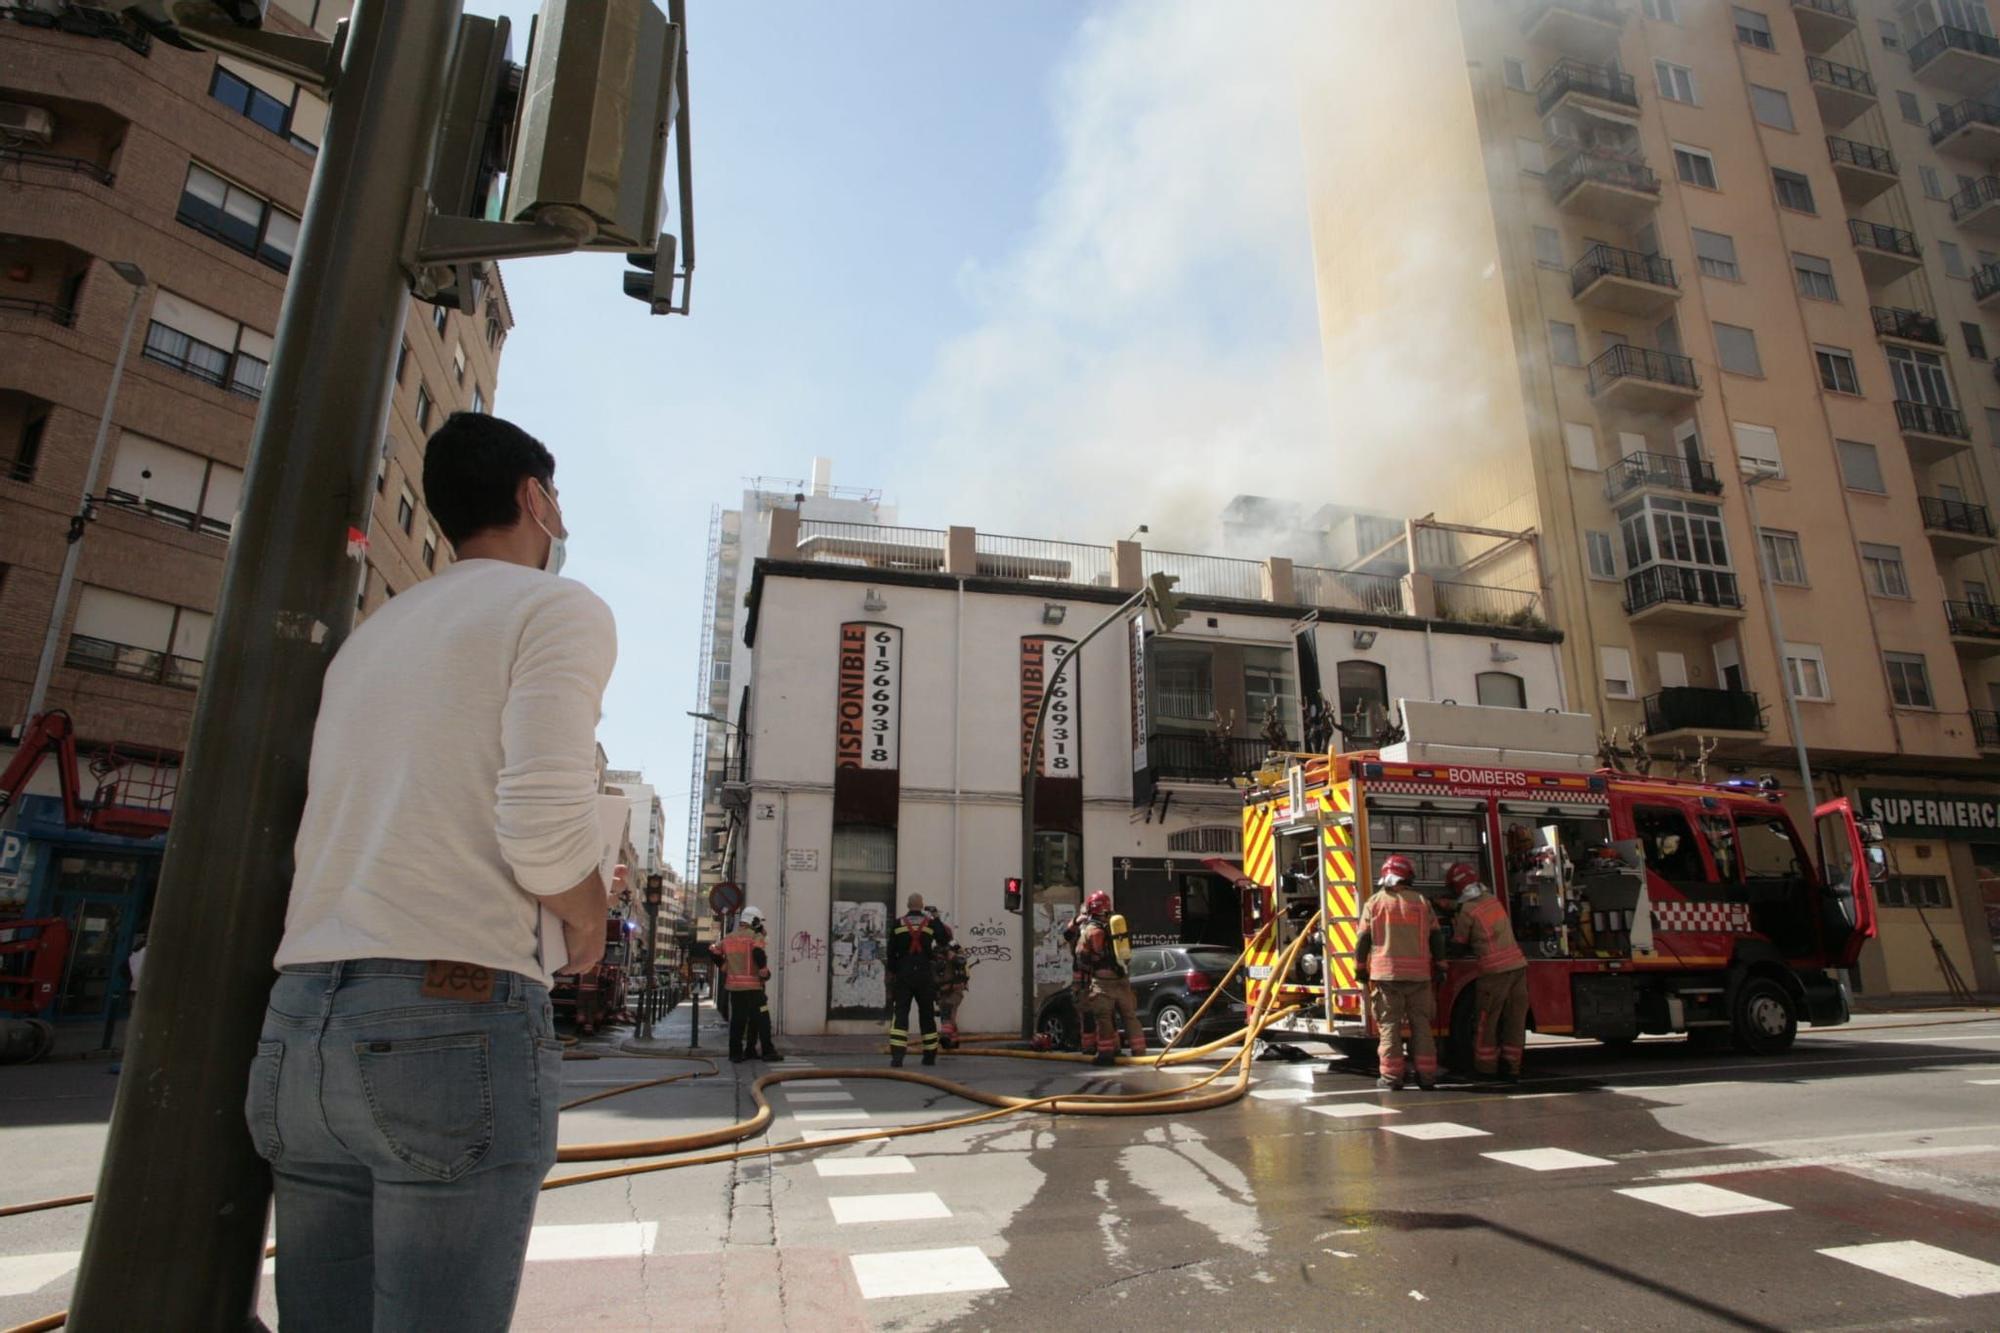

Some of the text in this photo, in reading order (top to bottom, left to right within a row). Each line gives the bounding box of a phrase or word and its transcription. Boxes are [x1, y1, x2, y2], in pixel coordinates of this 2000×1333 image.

[870, 631, 892, 762] 615669318
[1051, 644, 1070, 770] 65669318
[1449, 768, 1527, 786] BOMBERS
[1453, 787, 1529, 798] Ajuntament de Castelló
[1870, 797, 2000, 828] SUPERMERC
[0, 835, 21, 868] P
[426, 960, 489, 992] Lee
